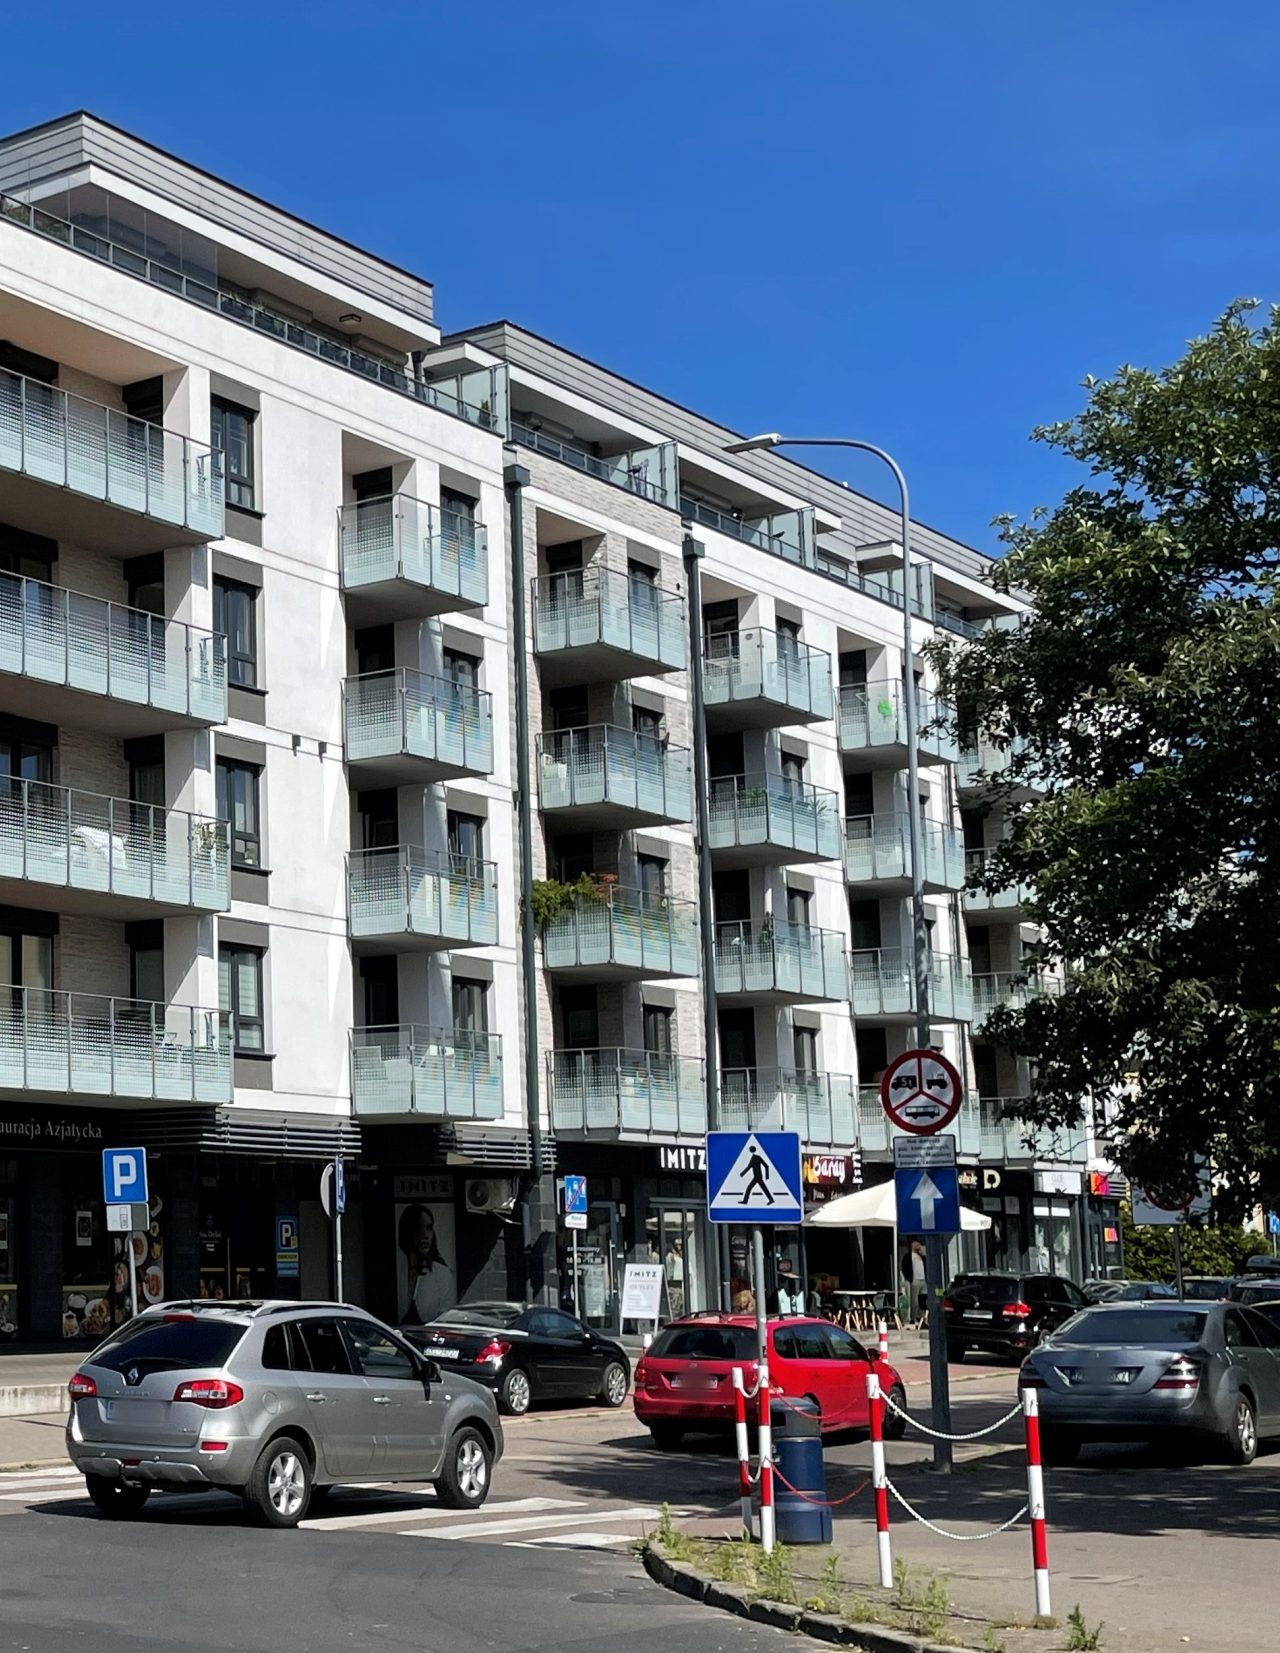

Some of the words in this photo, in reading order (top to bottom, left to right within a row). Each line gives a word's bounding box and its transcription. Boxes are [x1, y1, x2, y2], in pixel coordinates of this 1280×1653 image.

[45, 1119, 102, 1142] Azjatycka
[660, 1147, 706, 1170] IMITZ
[113, 1155, 137, 1197] P
[282, 1224, 292, 1245] P
